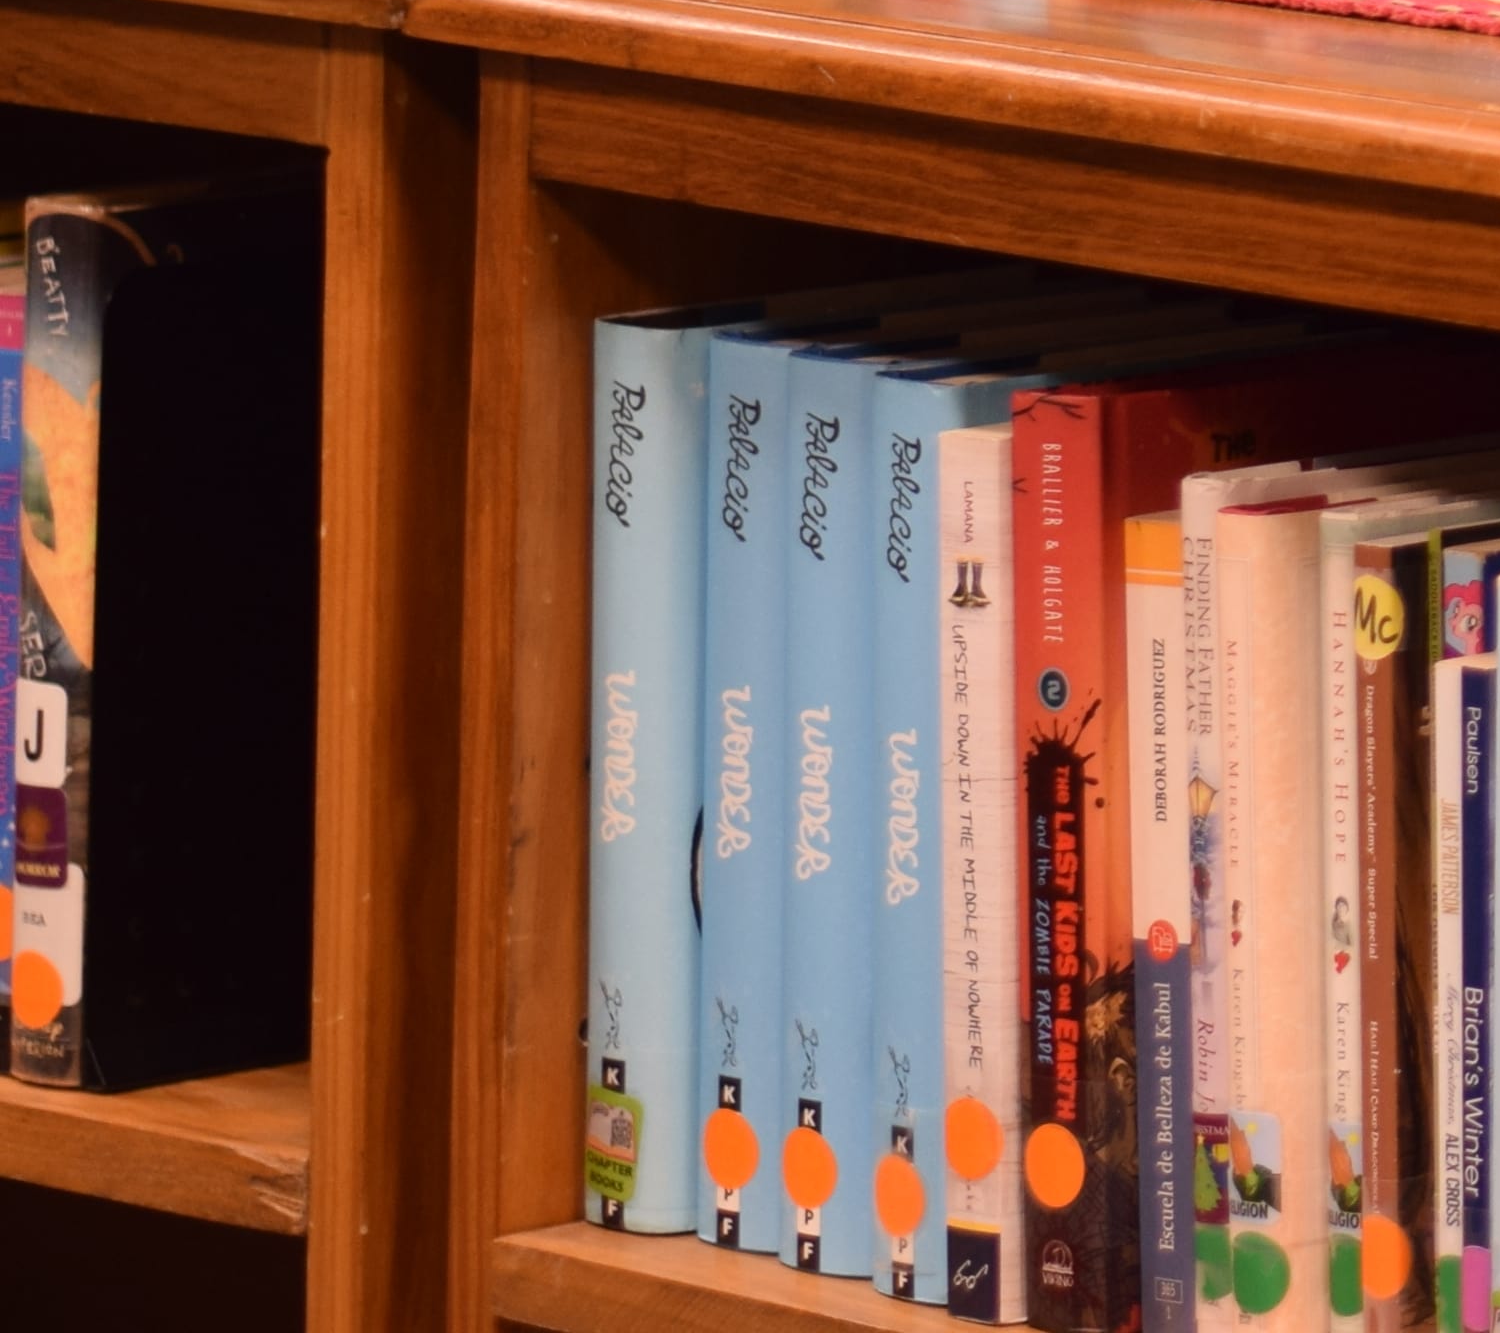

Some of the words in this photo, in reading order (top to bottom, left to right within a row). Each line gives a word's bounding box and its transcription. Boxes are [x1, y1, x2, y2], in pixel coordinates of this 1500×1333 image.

[36, 236, 69, 336] BEATTY
[963, 481, 974, 544] LAMANA
[1042, 443, 1063, 526] BRALLIER
[1045, 540, 1059, 550] &
[1043, 565, 1064, 643] HOLGATE
[1197, 536, 1213, 640] FINDING
[1353, 586, 1399, 644] Mc
[952, 624, 968, 706] UPSIDE
[1047, 680, 1060, 700] 2
[1152, 638, 1167, 736] RODRIGUEZ
[1198, 647, 1214, 736] FATHER
[1333, 611, 1349, 766] HANNAH'S
[24, 709, 44, 761] J
[1364, 685, 1376, 728] Dragon
[956, 714, 970, 766] DOWN
[1467, 706, 1481, 795] Paulsen
[959, 773, 972, 803] IN
[1155, 742, 1167, 822] DEBORAH
[960, 811, 975, 850] THE
[1036, 815, 1047, 849] and
[1227, 761, 1239, 868] MIRACLE
[1334, 783, 1349, 863] HOPE
[1036, 858, 1052, 886] the
[1053, 811, 1079, 893] LAST
[962, 859, 978, 944] MIDDLE
[1367, 867, 1377, 906] Super
[966, 950, 979, 973] OF
[1035, 899, 1050, 975] ZOMBIE
[1055, 901, 1079, 977] KIDS
[1368, 906, 1379, 960] Special
[967, 980, 984, 1071] NOWHERE
[1057, 985, 1072, 1011] ON
[1154, 982, 1172, 1039] Kabul
[1036, 989, 1053, 1065] PARADE
[1197, 1018, 1215, 1091] Robin
[1336, 1000, 1349, 1061] Karen
[1464, 986, 1483, 1084] Brian's
[608, 1067, 619, 1086] K
[1055, 1018, 1080, 1120] EARTH
[1156, 1044, 1172, 1069] de
[723, 1085, 735, 1104] K
[804, 1108, 815, 1127] K
[1156, 1074, 1173, 1143] Belleza
[897, 1136, 908, 1153] K
[1157, 1147, 1173, 1172] de
[1445, 1132, 1460, 1174] ALEX
[1465, 1098, 1485, 1198] Winter
[608, 1200, 618, 1216] F
[723, 1218, 732, 1236] F
[805, 1209, 813, 1225] P
[1157, 1180, 1175, 1251] Escuela
[1445, 1176, 1460, 1226] CROSS
[803, 1243, 813, 1261] F
[899, 1236, 907, 1253] P
[898, 1270, 907, 1287] F
